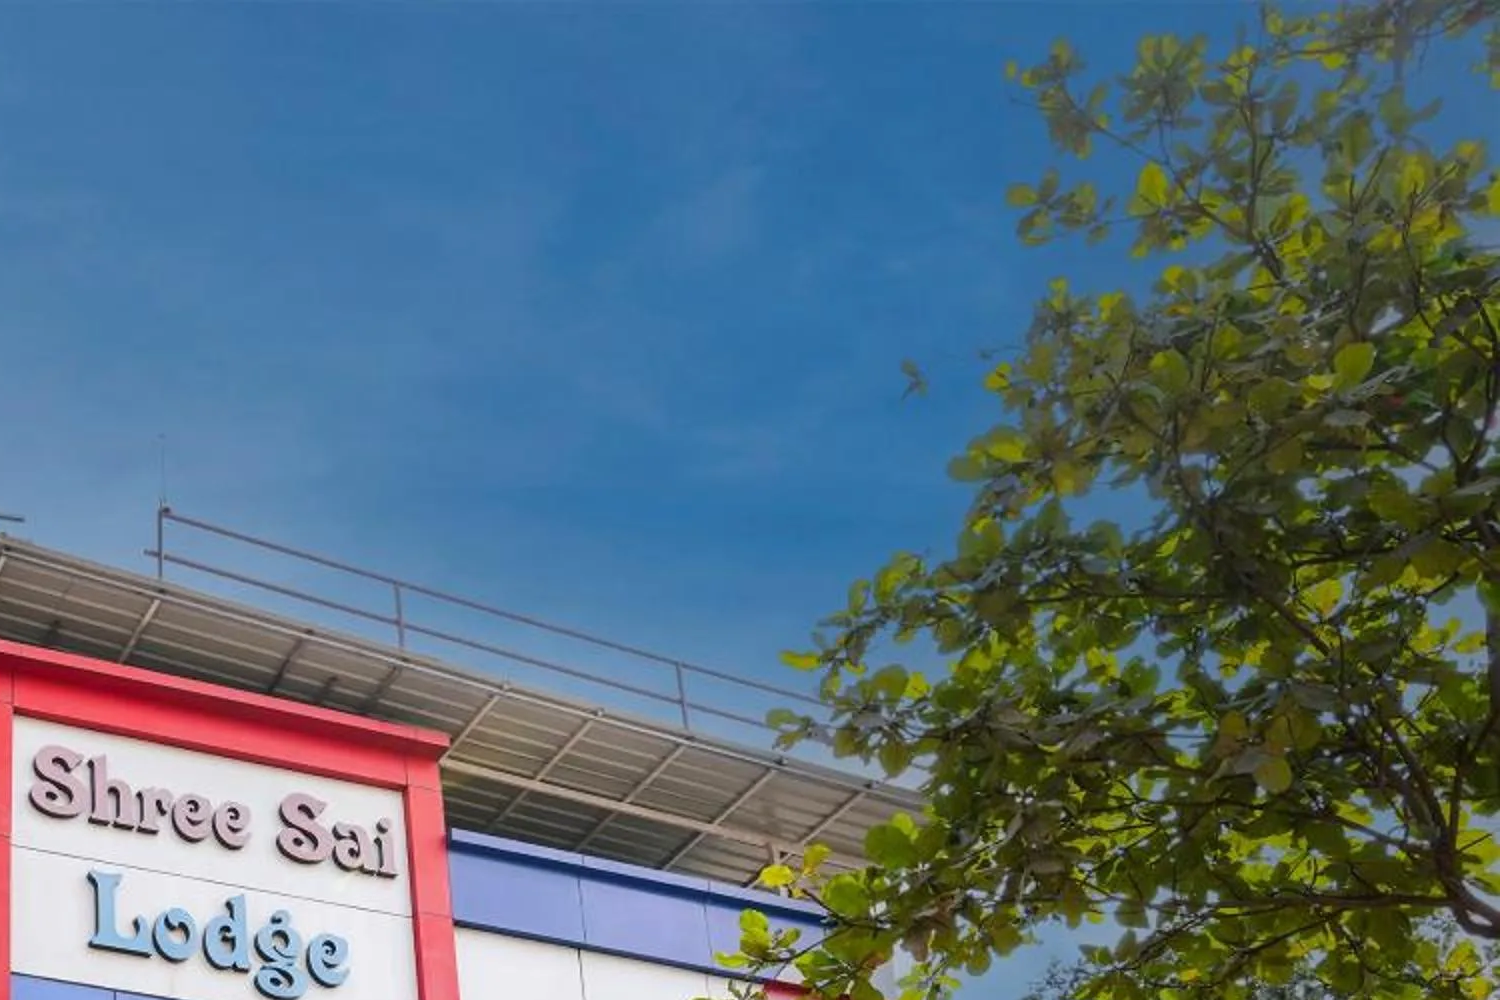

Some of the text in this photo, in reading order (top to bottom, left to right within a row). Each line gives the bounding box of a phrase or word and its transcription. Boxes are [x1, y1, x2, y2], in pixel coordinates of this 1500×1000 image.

[29, 744, 398, 879] Shree Sai
[87, 869, 351, 1000] Lodge
